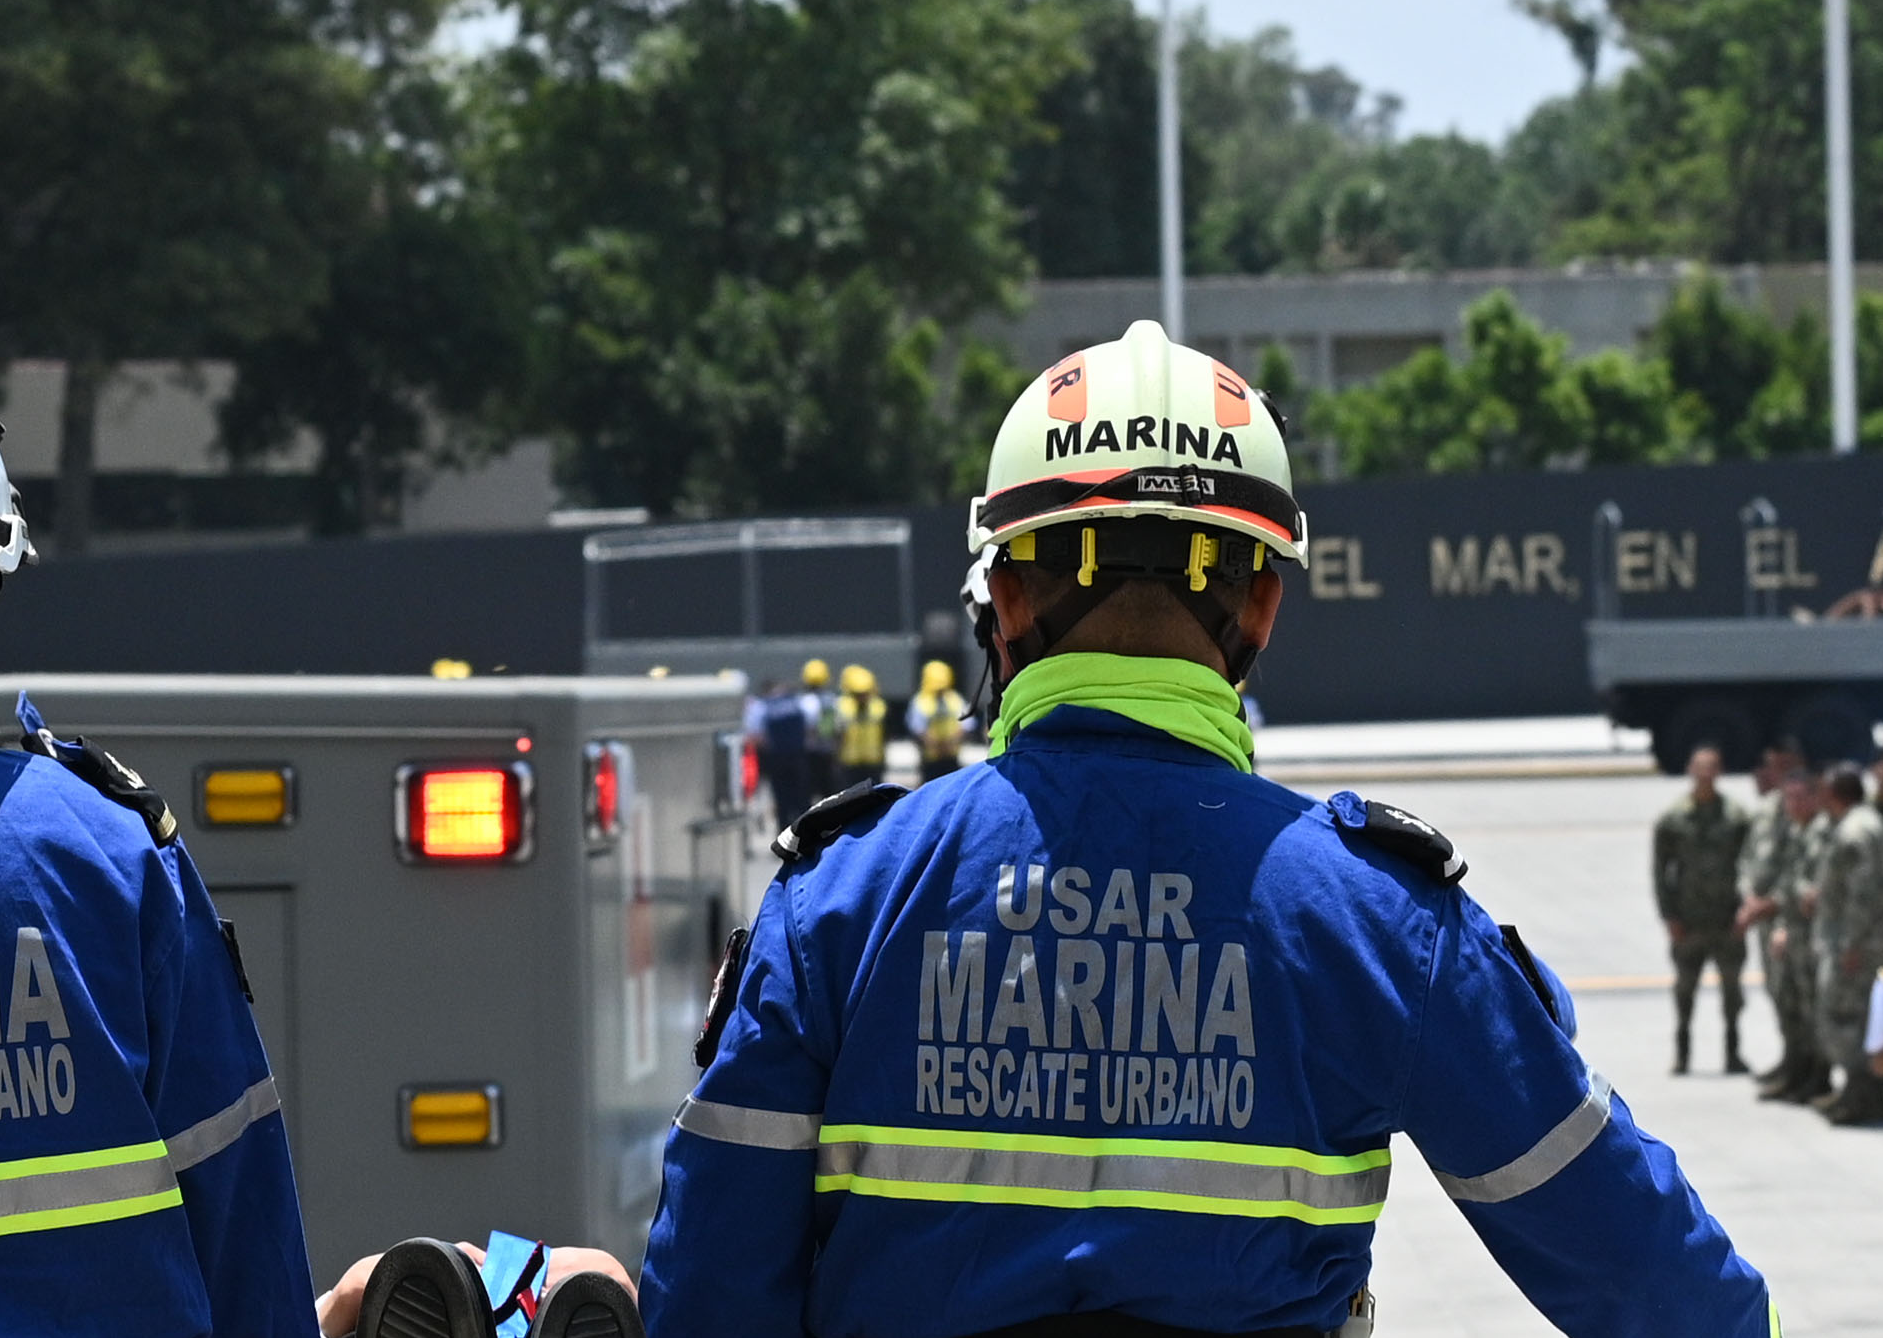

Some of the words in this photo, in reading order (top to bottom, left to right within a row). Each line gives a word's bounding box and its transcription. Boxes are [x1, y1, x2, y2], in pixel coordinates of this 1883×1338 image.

[1046, 416, 1243, 469] MARINA
[1310, 536, 1382, 600] EL
[1429, 533, 1581, 602] MAR,
[1618, 530, 1697, 591] EN
[1745, 528, 1817, 589] EL
[996, 864, 1194, 939] USAR
[918, 931, 1256, 1057] MARINA
[916, 1045, 1089, 1121] RESCATE
[1099, 1055, 1254, 1129] URBANO
